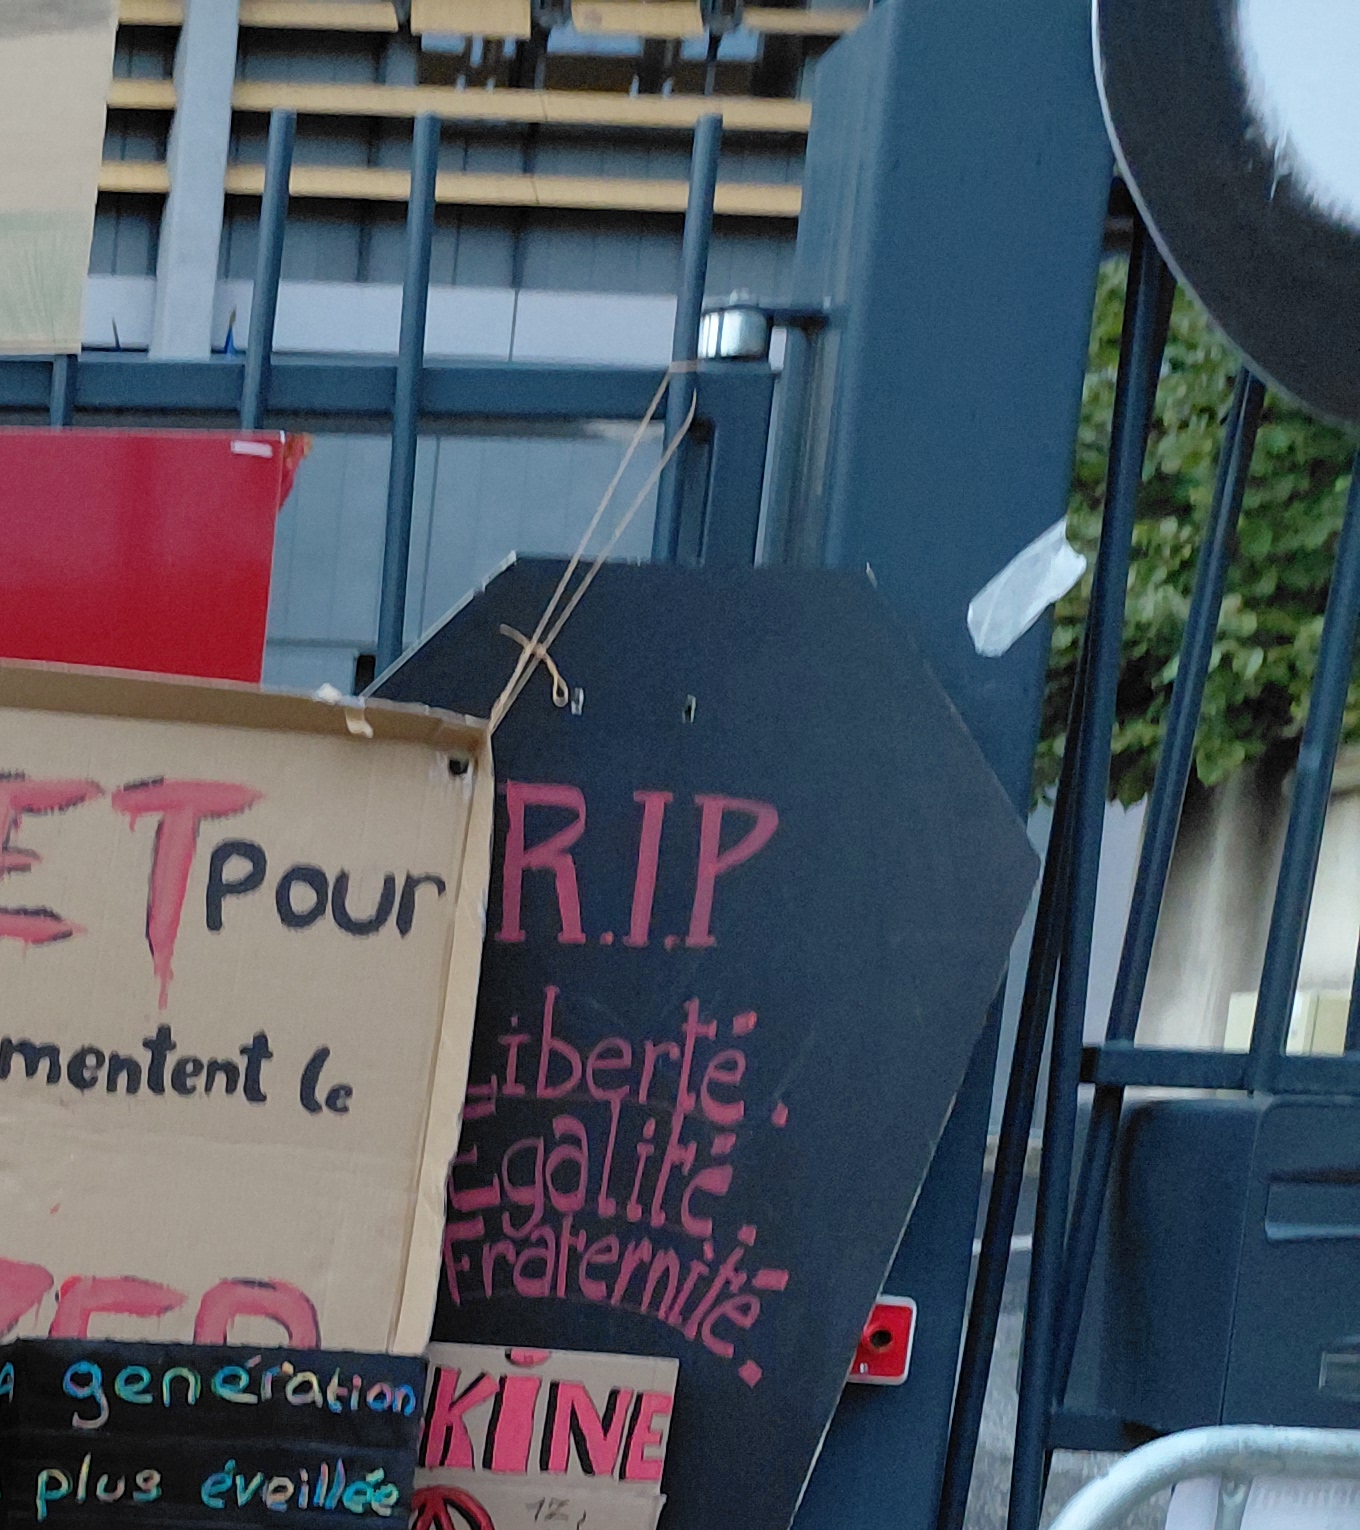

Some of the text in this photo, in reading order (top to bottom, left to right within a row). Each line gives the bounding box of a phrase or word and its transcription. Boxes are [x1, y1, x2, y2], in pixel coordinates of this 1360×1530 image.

[496, 780, 780, 948] R.I.P
[299, 1046, 354, 1115] le
[35, 1451, 163, 1523] plus
